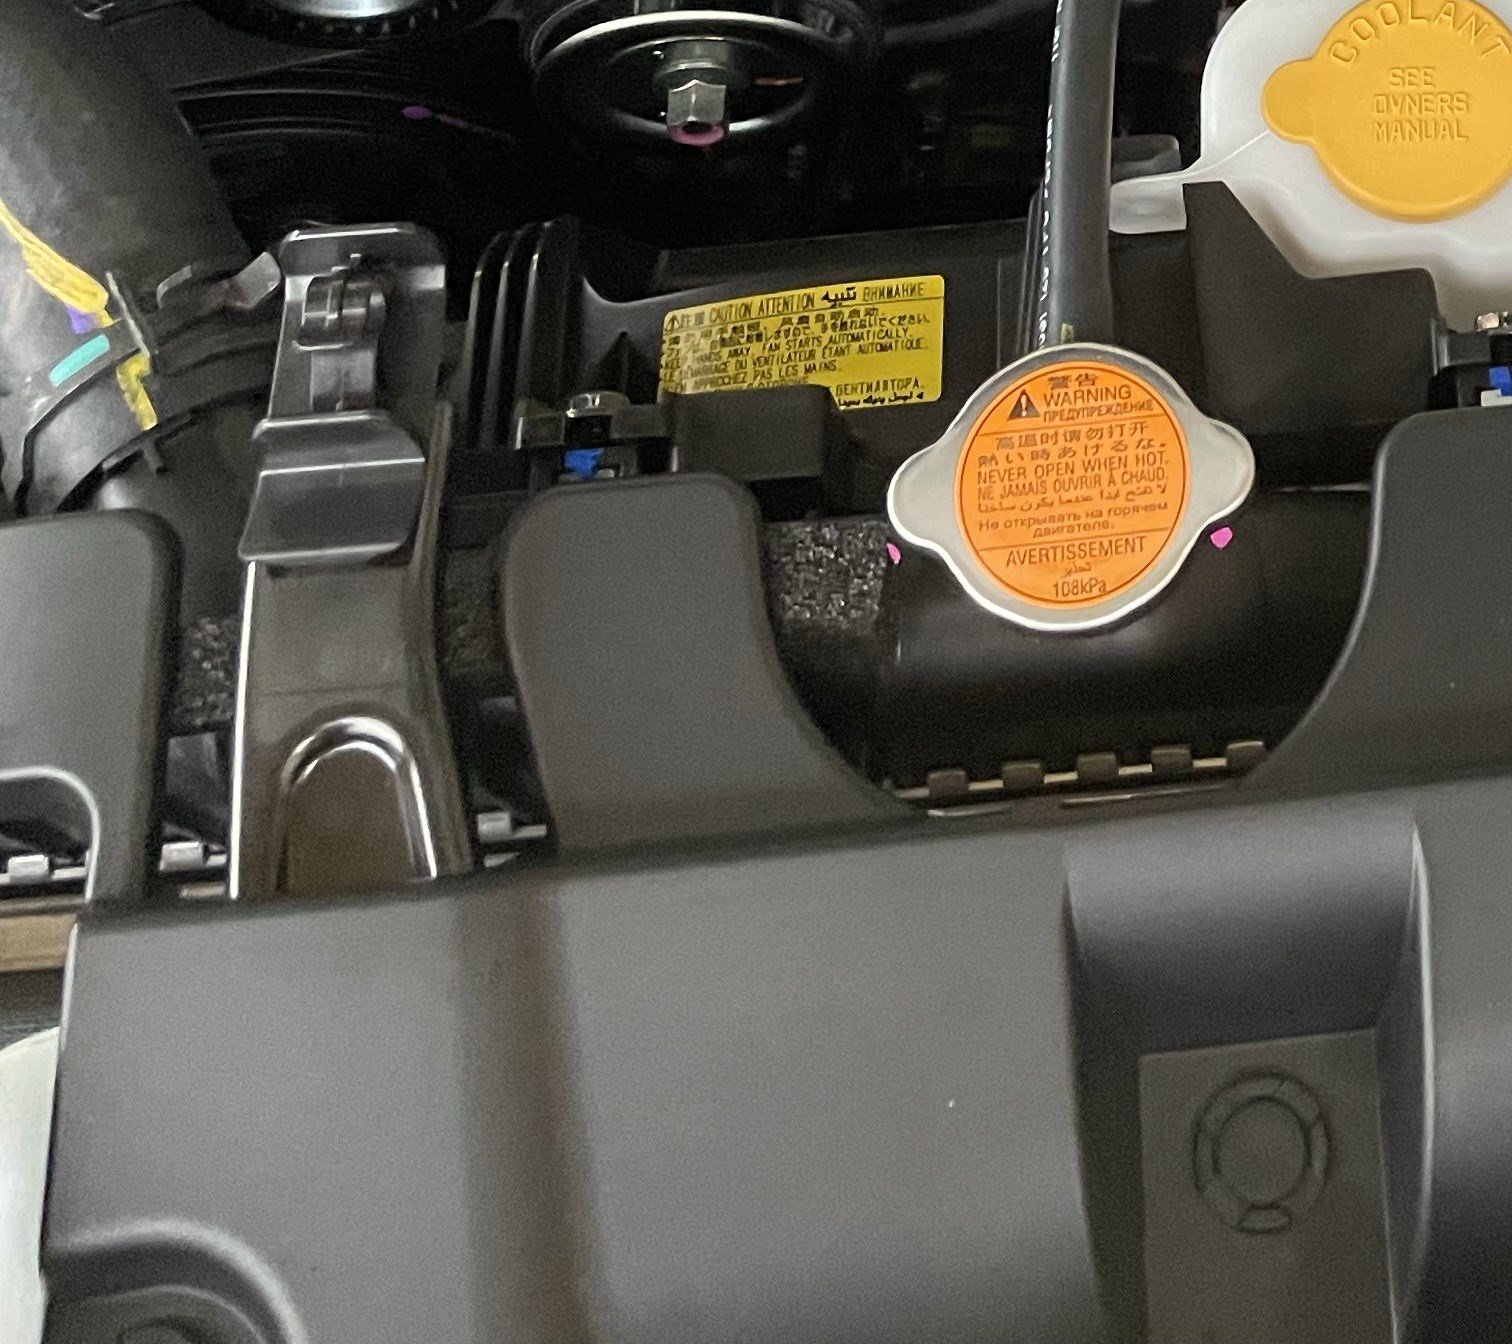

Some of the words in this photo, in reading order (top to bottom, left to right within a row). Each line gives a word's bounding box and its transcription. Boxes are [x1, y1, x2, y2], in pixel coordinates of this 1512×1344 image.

[1387, 66, 1436, 87] SEE
[1374, 118, 1470, 143] MANUAL
[709, 303, 751, 322] CAUTION
[757, 292, 815, 314] ATTENTION
[786, 337, 822, 349] STARTS
[1043, 384, 1132, 407] WARNING
[1042, 399, 1154, 423] ПРЕДУПРЕЖДЕНИЕ
[978, 467, 1026, 484] NEVER
[1033, 461, 1076, 478] OPEN
[1082, 455, 1128, 473] WHEN
[1135, 450, 1168, 467] HOT.
[977, 485, 994, 501] NE
[999, 480, 1047, 498] JAMAIS
[1052, 474, 1102, 492] OUVRIR
[1120, 466, 1167, 485] CHAUD.
[978, 519, 999, 530] Не
[1003, 511, 1081, 530] открывать
[1085, 509, 1103, 519] на
[1107, 501, 1167, 518] горячем
[1005, 535, 1148, 567] AVERTISSEMENT
[1052, 576, 1107, 598] 108kPa
